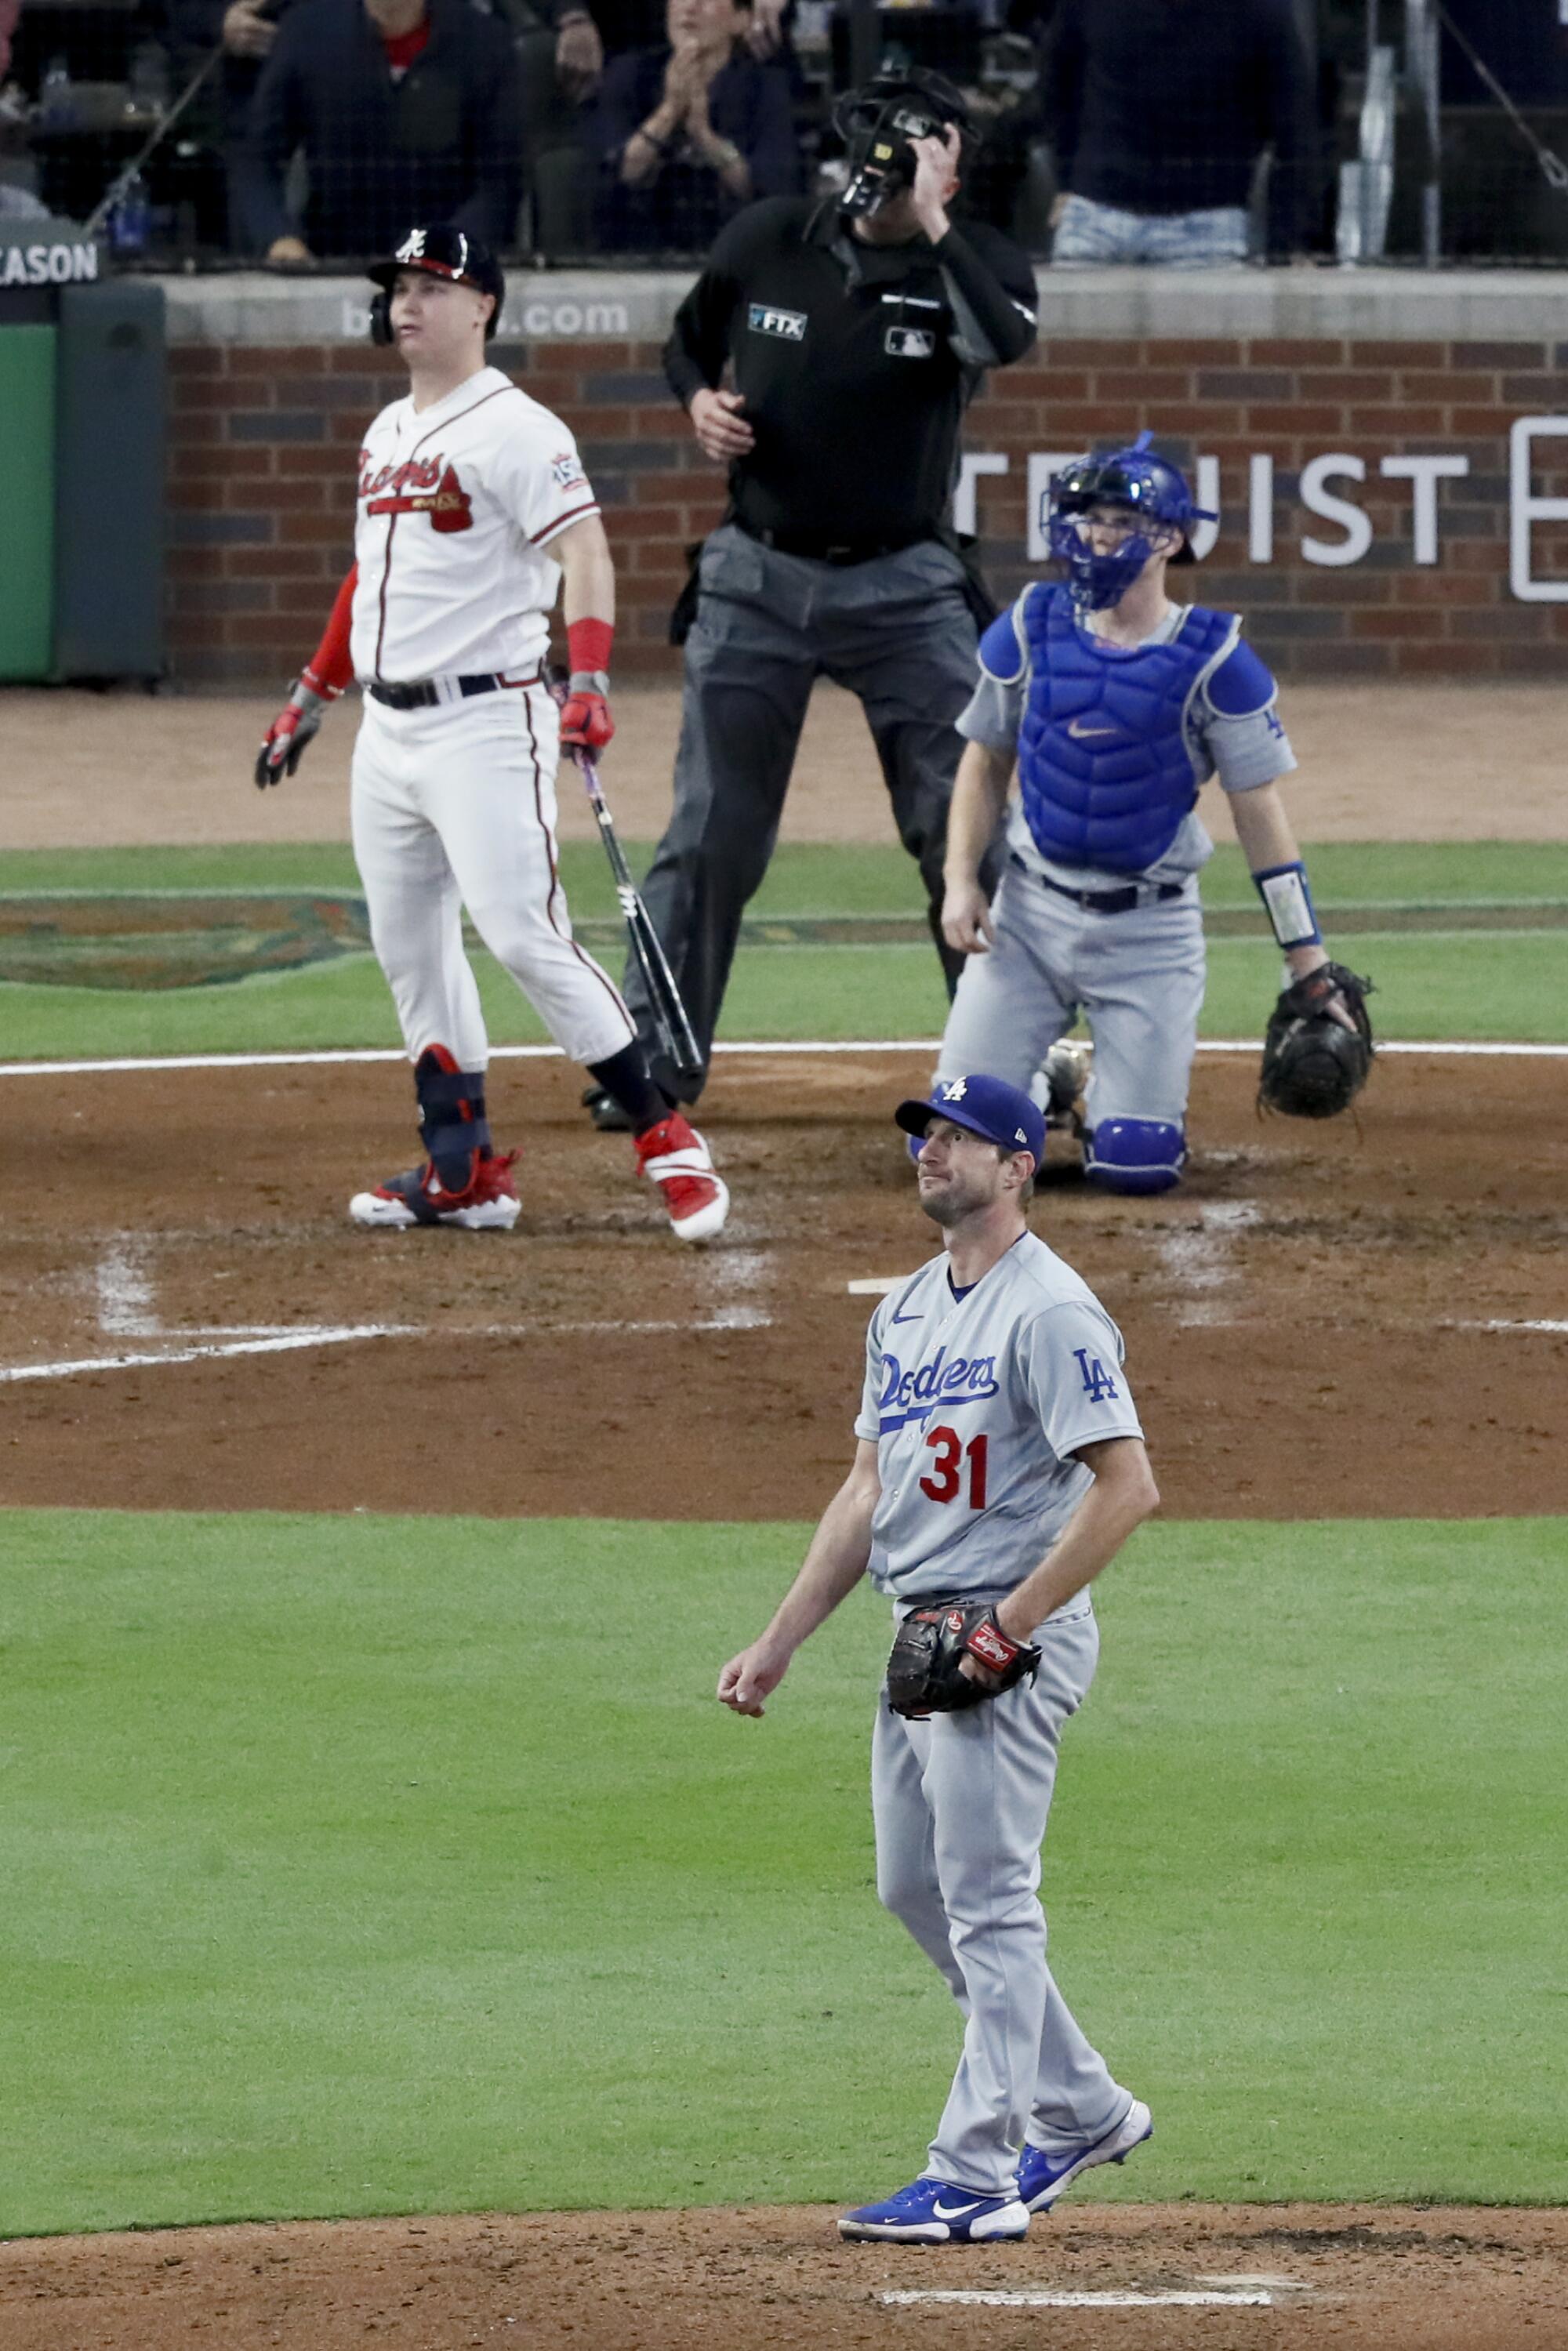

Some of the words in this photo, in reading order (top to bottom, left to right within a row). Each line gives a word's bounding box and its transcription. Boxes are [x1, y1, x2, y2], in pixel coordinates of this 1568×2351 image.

[763, 312, 801, 336] FTX
[878, 1345, 1000, 1435] Doders
[1073, 1348, 1119, 1403] LA
[920, 1425, 989, 1510] 31
